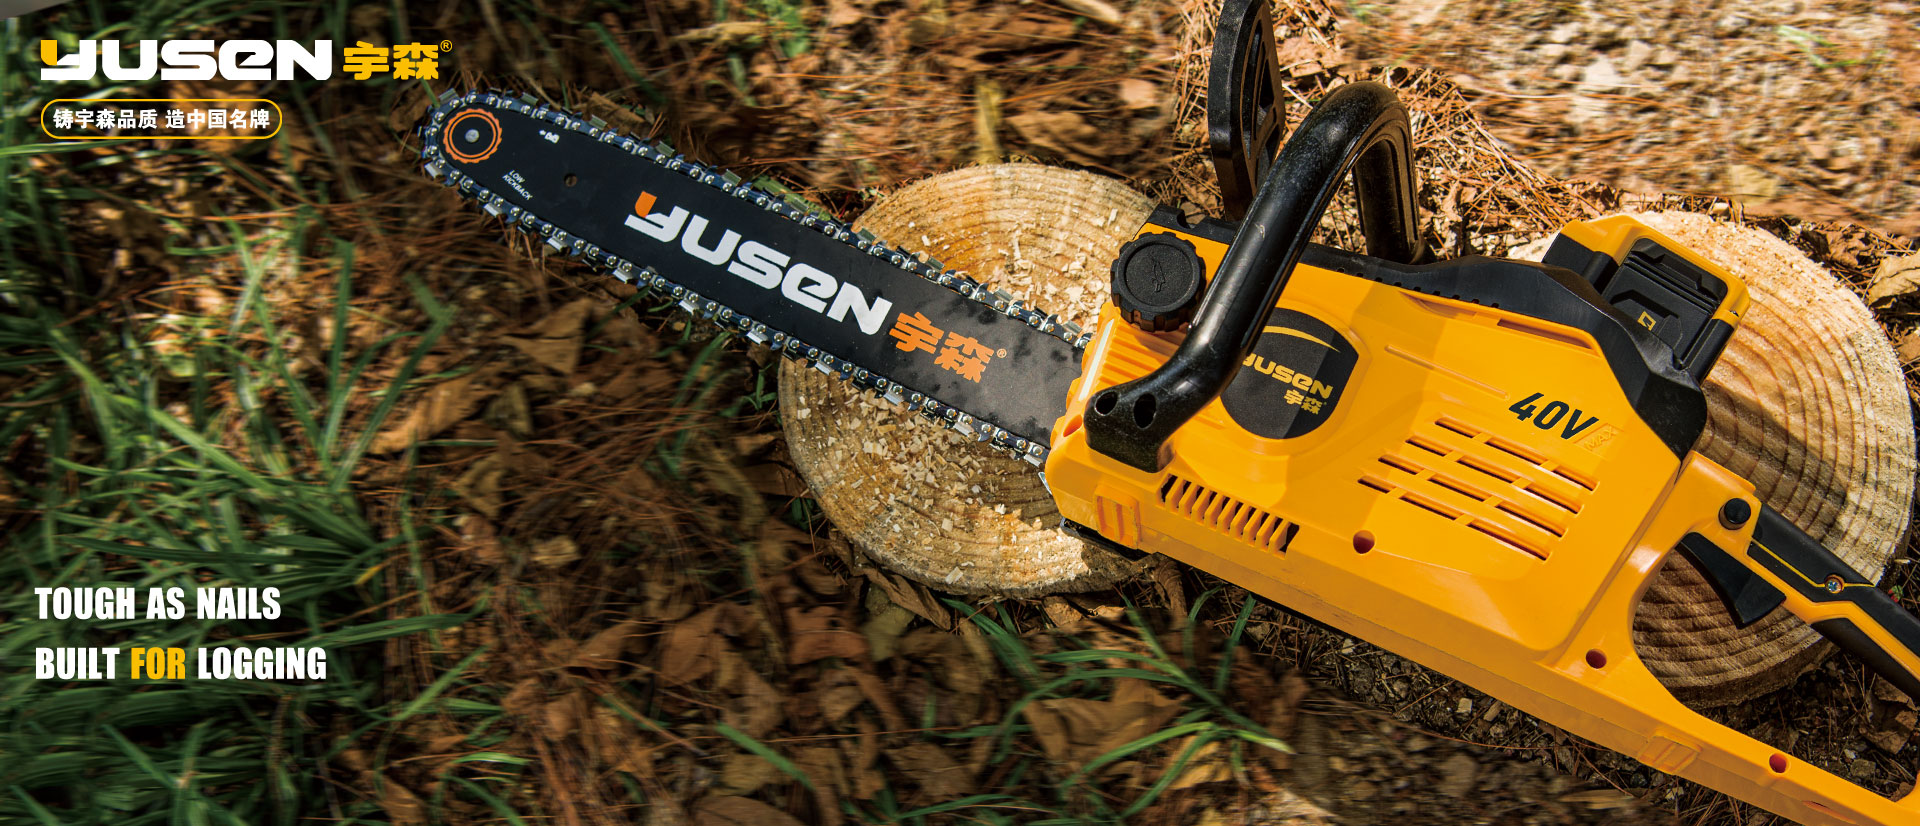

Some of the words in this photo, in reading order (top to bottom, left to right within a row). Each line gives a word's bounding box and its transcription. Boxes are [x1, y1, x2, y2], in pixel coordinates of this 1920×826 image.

[502, 174, 533, 201] KICKBACK
[508, 169, 525, 183] LOW
[1508, 392, 1600, 440] 40V
[1583, 425, 1618, 452] MAX
